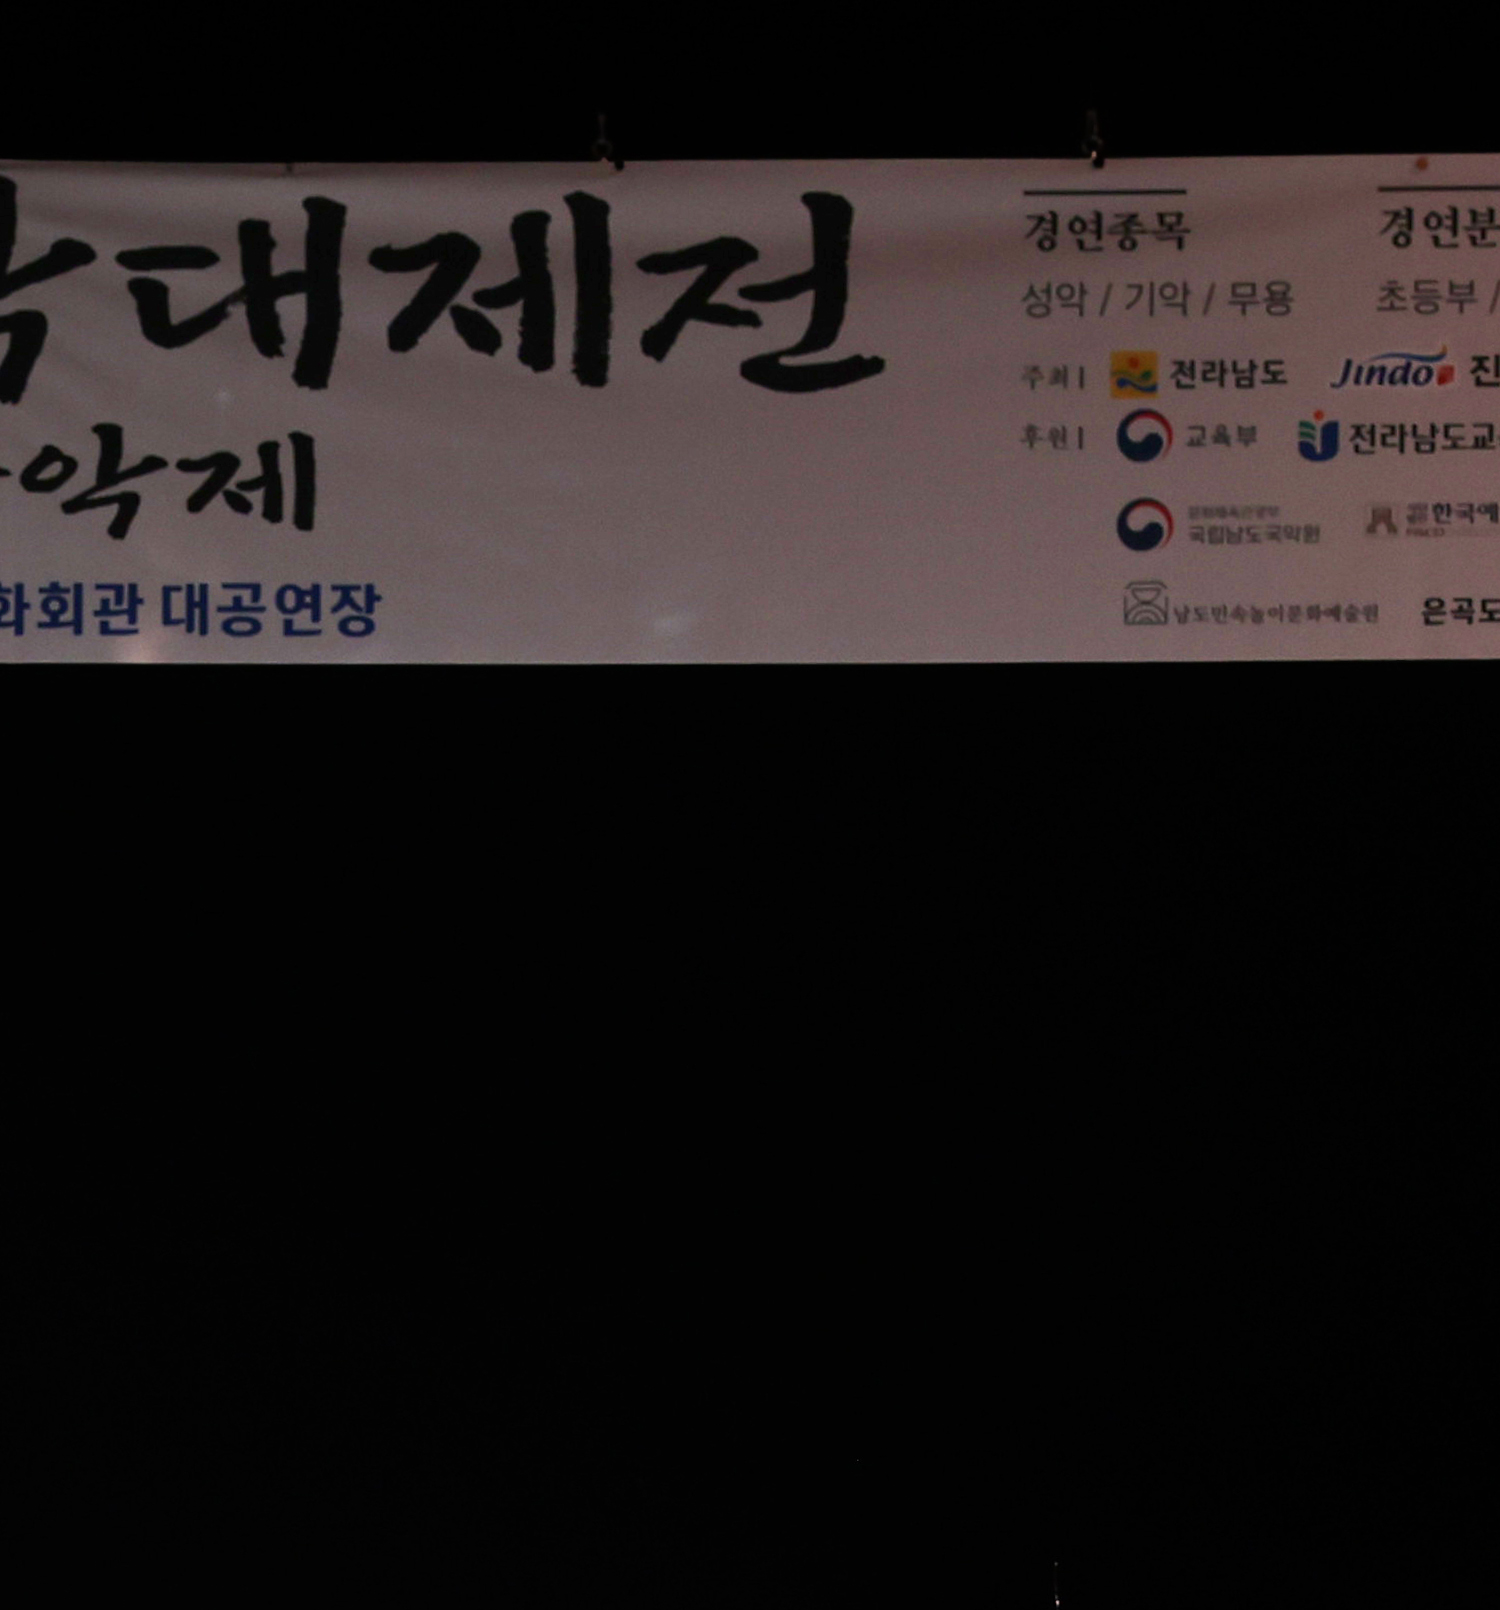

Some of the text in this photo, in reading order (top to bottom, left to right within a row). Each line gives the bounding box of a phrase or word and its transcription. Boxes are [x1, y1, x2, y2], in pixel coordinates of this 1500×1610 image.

[1024, 210, 1191, 254] 경연종목
[1021, 280, 1089, 318] 성악
[1125, 280, 1192, 318] 기악
[1227, 280, 1294, 318] 무용
[1376, 278, 1478, 316] 초등부
[1170, 358, 1288, 390] 전라남도
[1330, 356, 1436, 389] Jindo
[1186, 423, 1257, 448] 교육부
[161, 582, 383, 638] 대공연장
